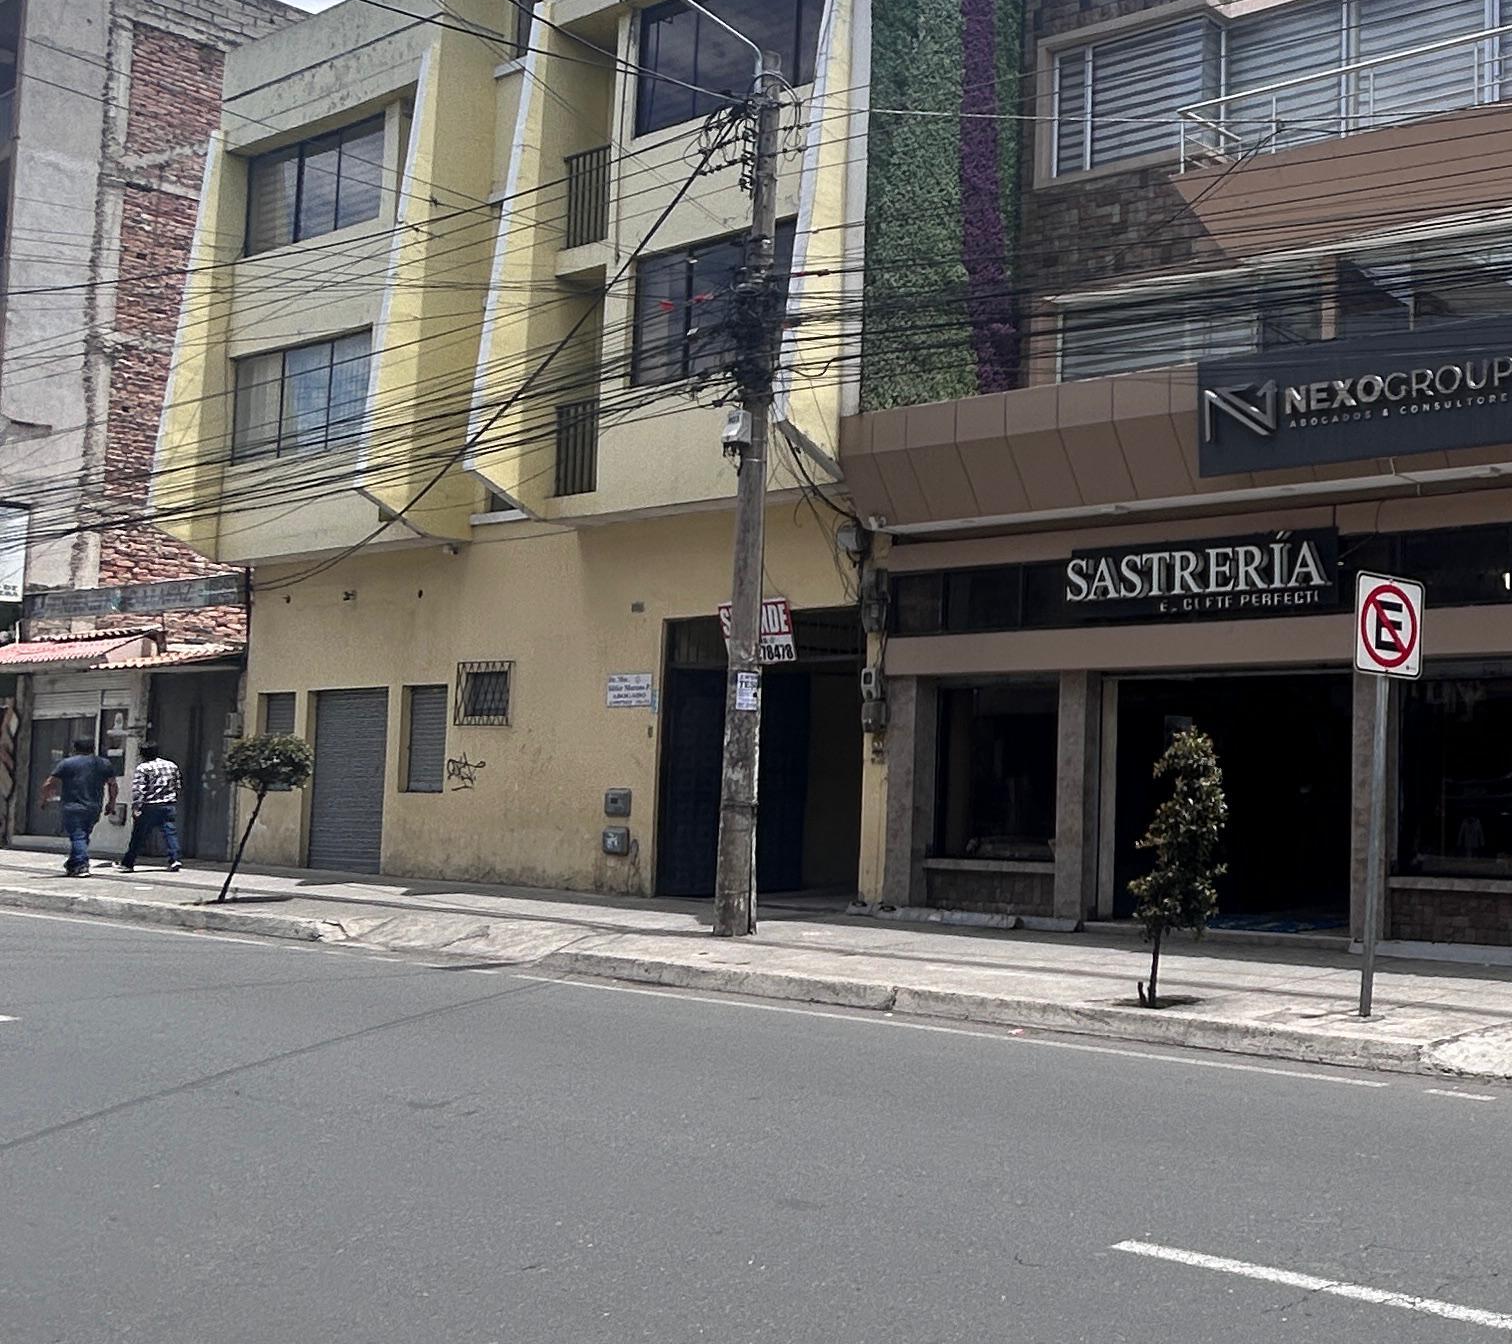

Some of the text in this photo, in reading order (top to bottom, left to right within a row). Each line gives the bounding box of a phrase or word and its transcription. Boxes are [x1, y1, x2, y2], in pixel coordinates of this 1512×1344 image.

[1066, 530, 1331, 601] SASTRERÍA
[720, 602, 789, 637] S NDE
[1375, 600, 1403, 652] E
